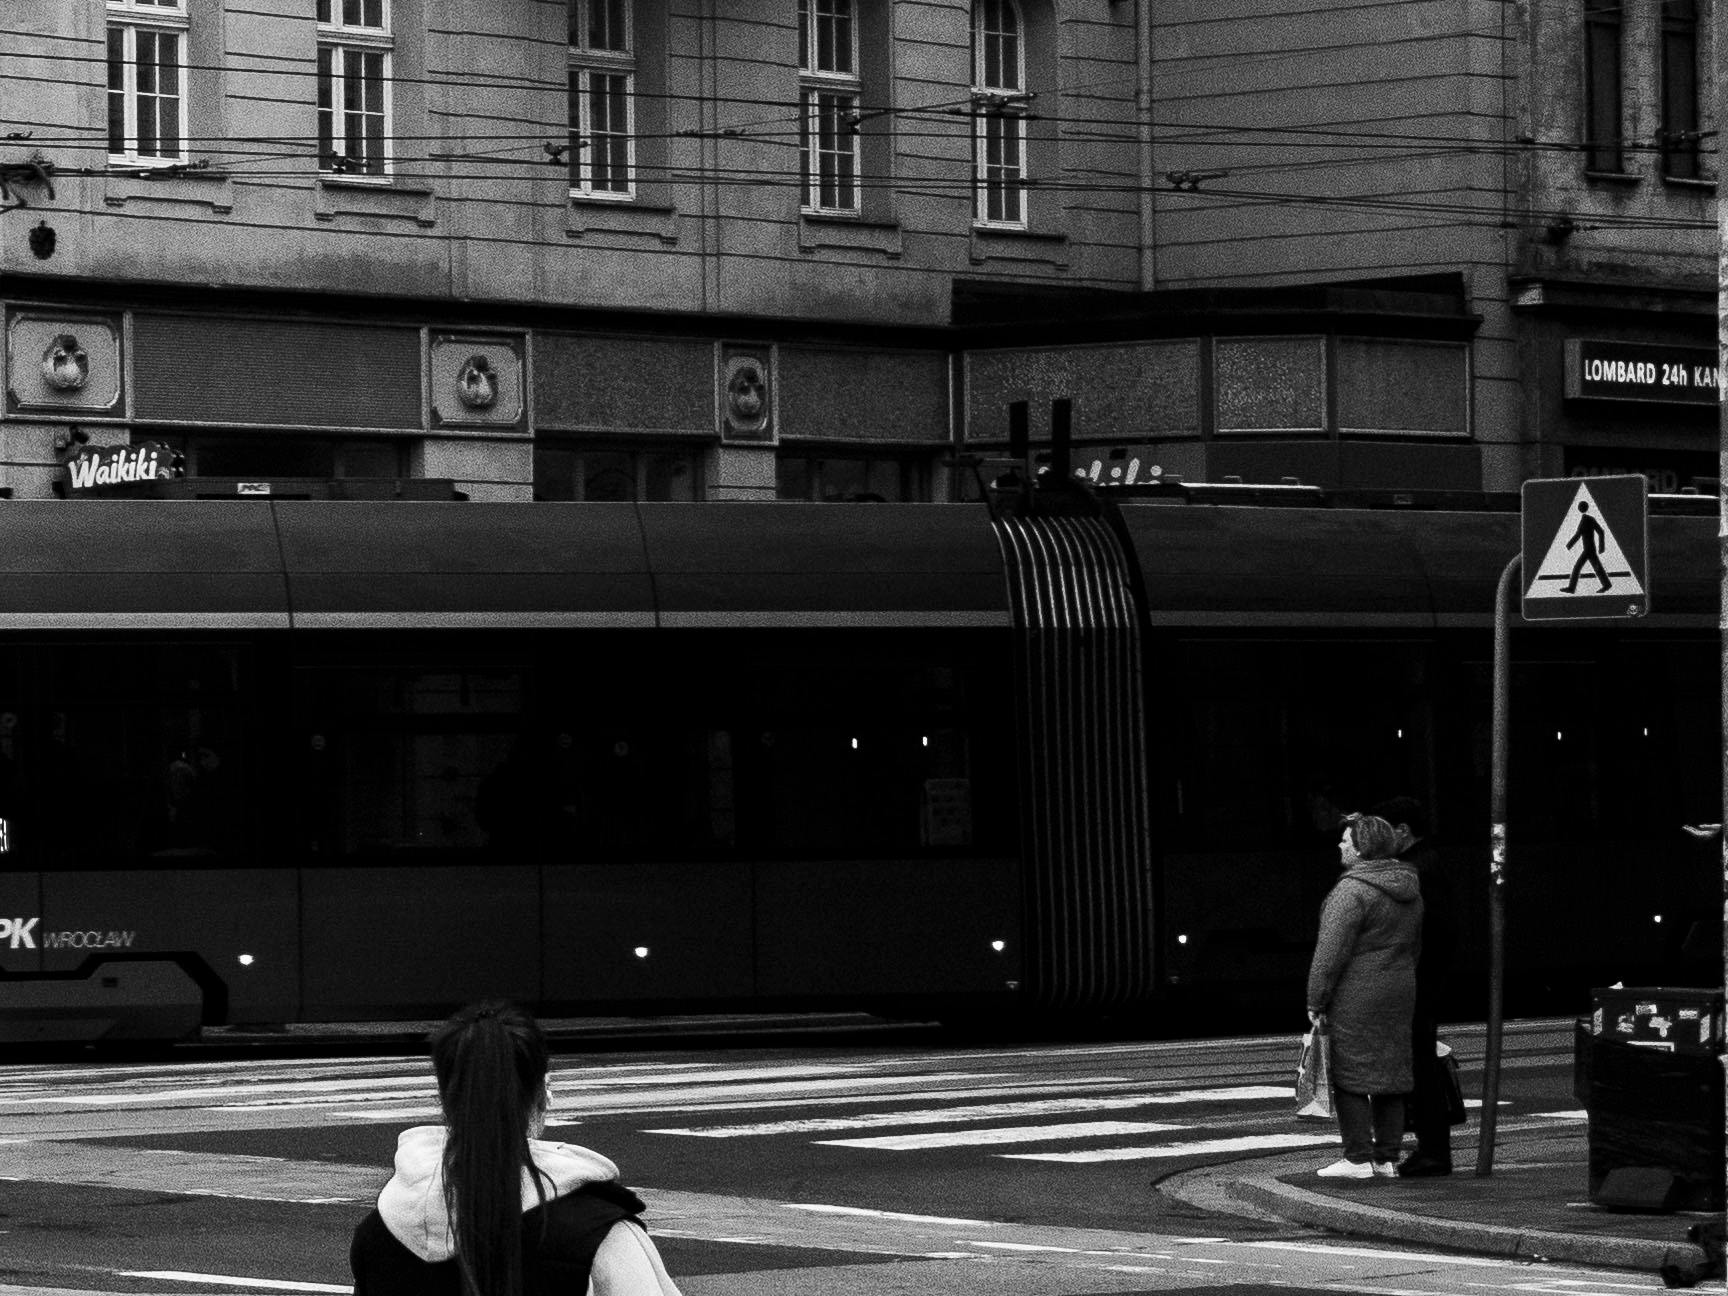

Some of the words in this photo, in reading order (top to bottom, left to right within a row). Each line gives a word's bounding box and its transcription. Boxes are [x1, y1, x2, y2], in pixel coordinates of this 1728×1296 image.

[1585, 359, 1656, 384] LOMBARD
[1662, 363, 1688, 386] 24h
[68, 447, 158, 489] Waikiki
